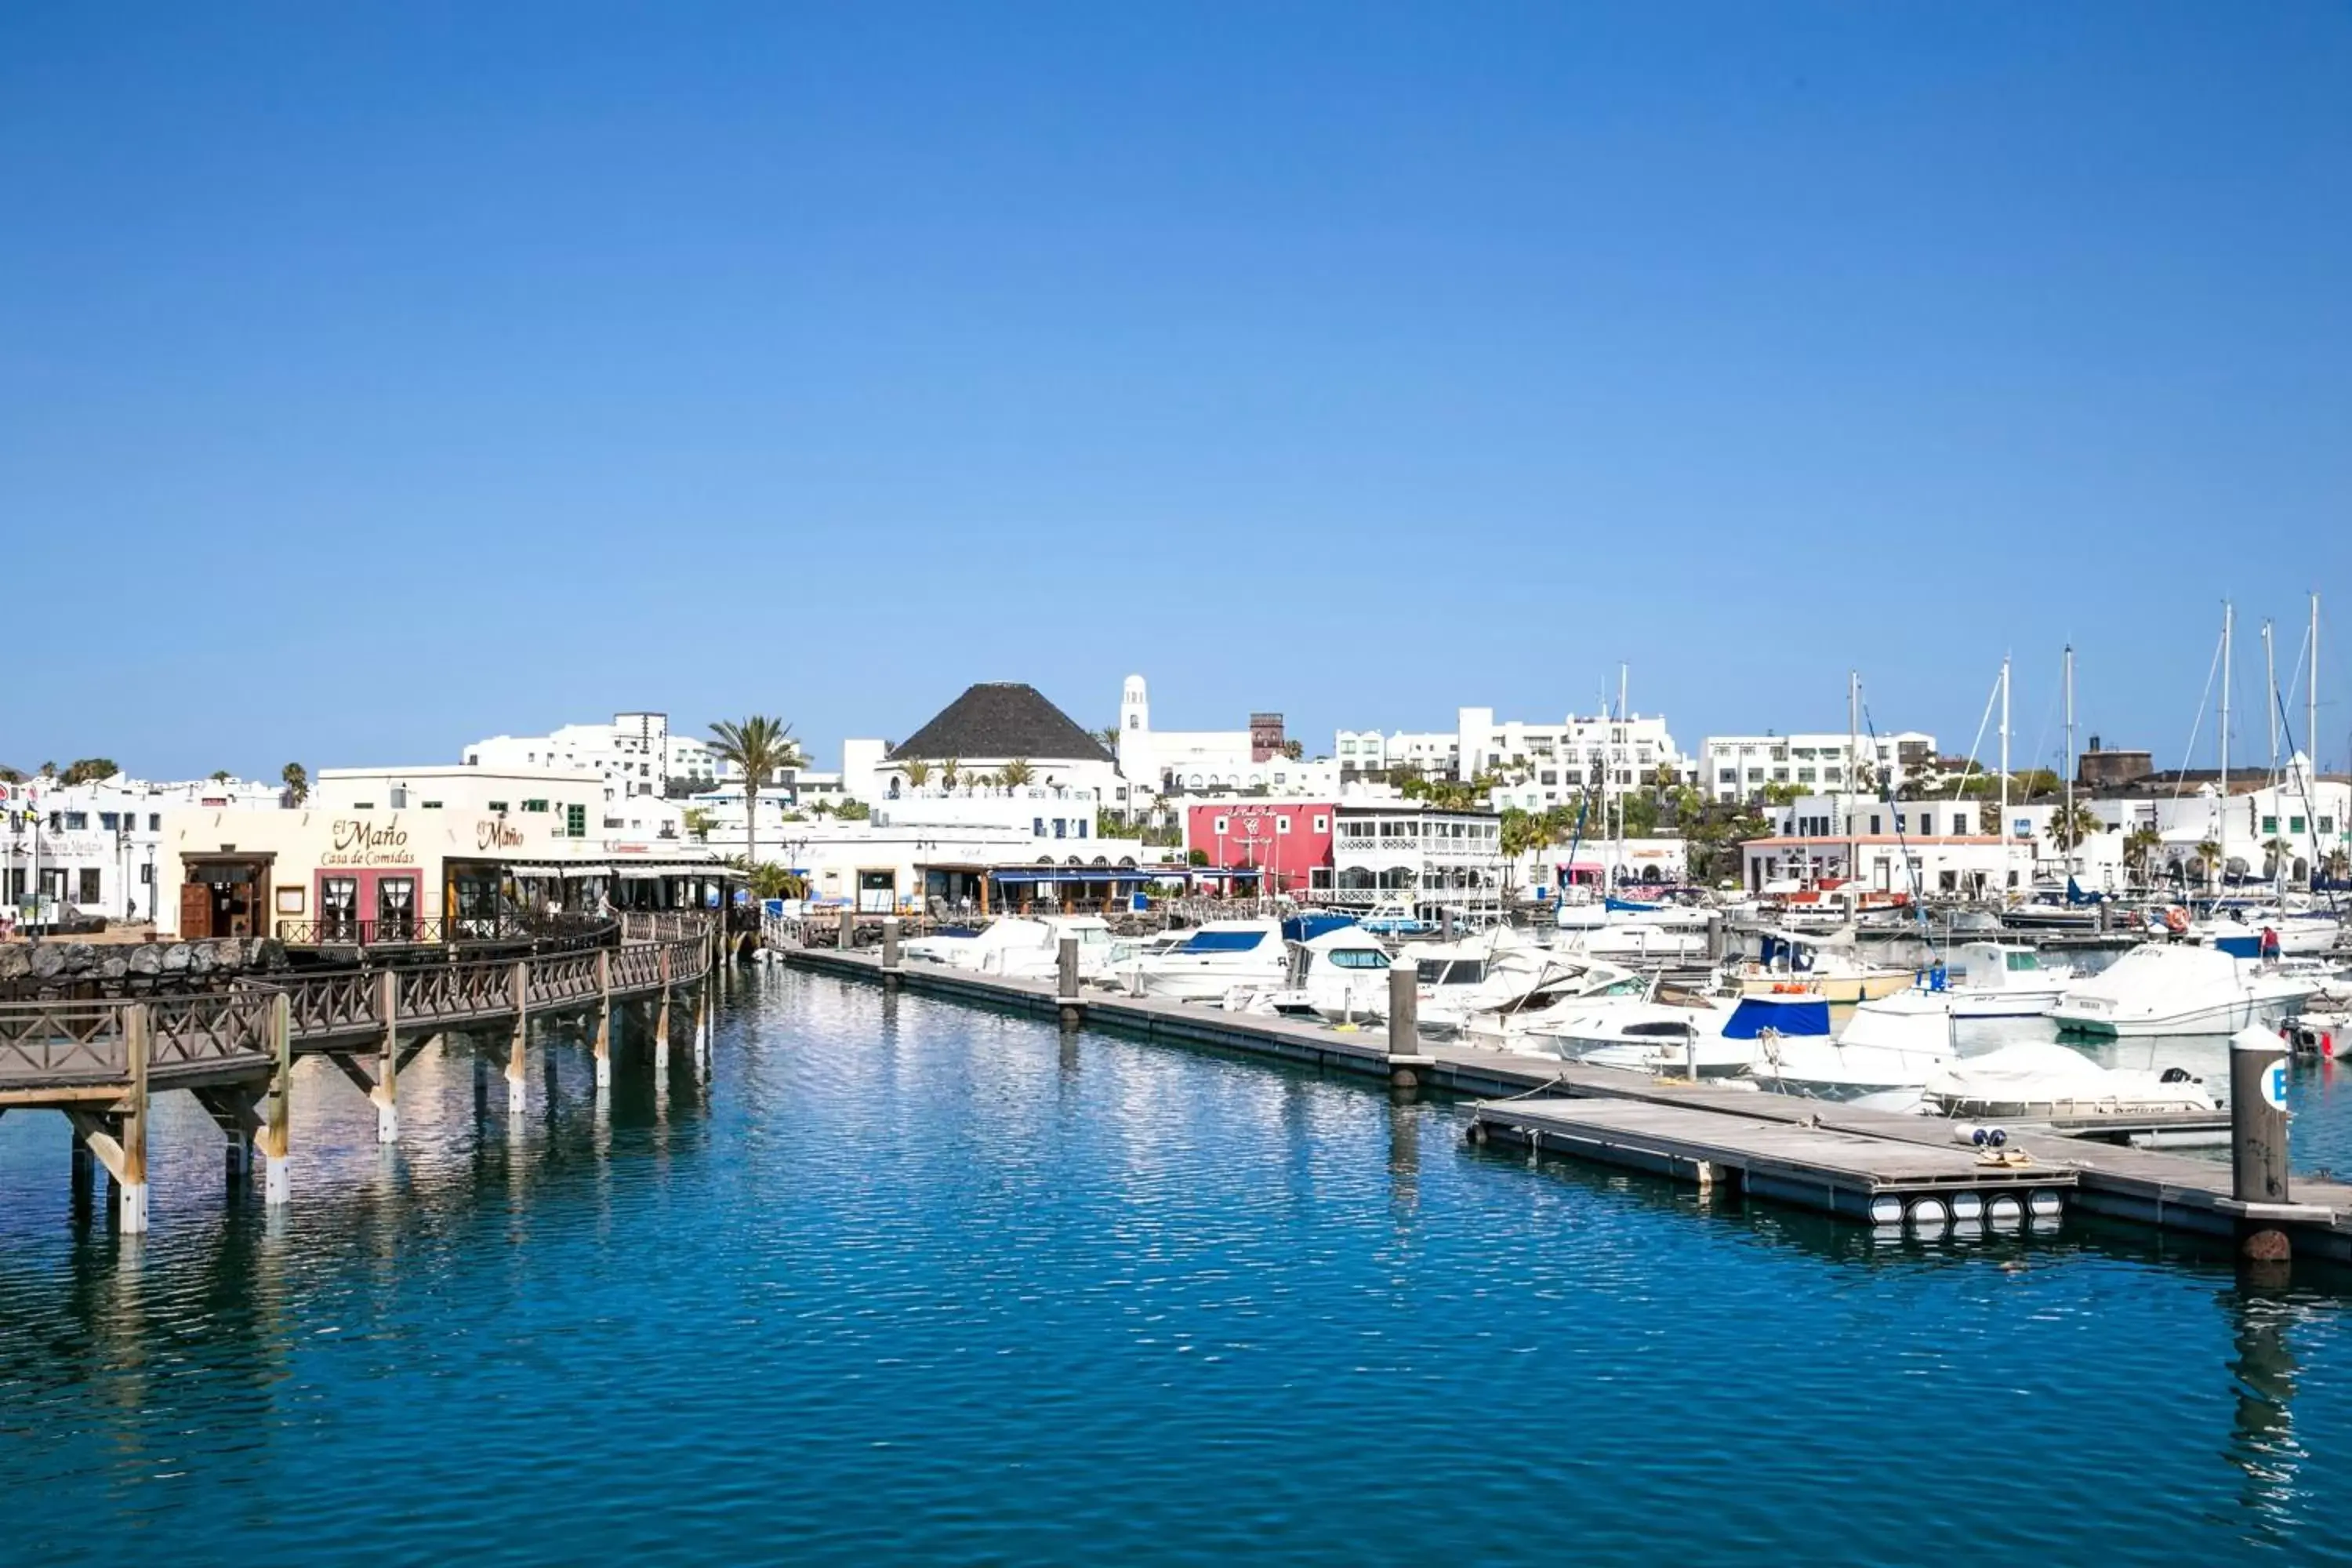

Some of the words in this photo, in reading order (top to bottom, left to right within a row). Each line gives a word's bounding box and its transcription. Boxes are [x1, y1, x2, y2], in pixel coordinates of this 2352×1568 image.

[333, 820, 346, 834] El
[335, 821, 407, 851] Maño
[321, 851, 347, 866] Casa
[351, 850, 363, 864] de
[366, 849, 415, 866] Comidas
